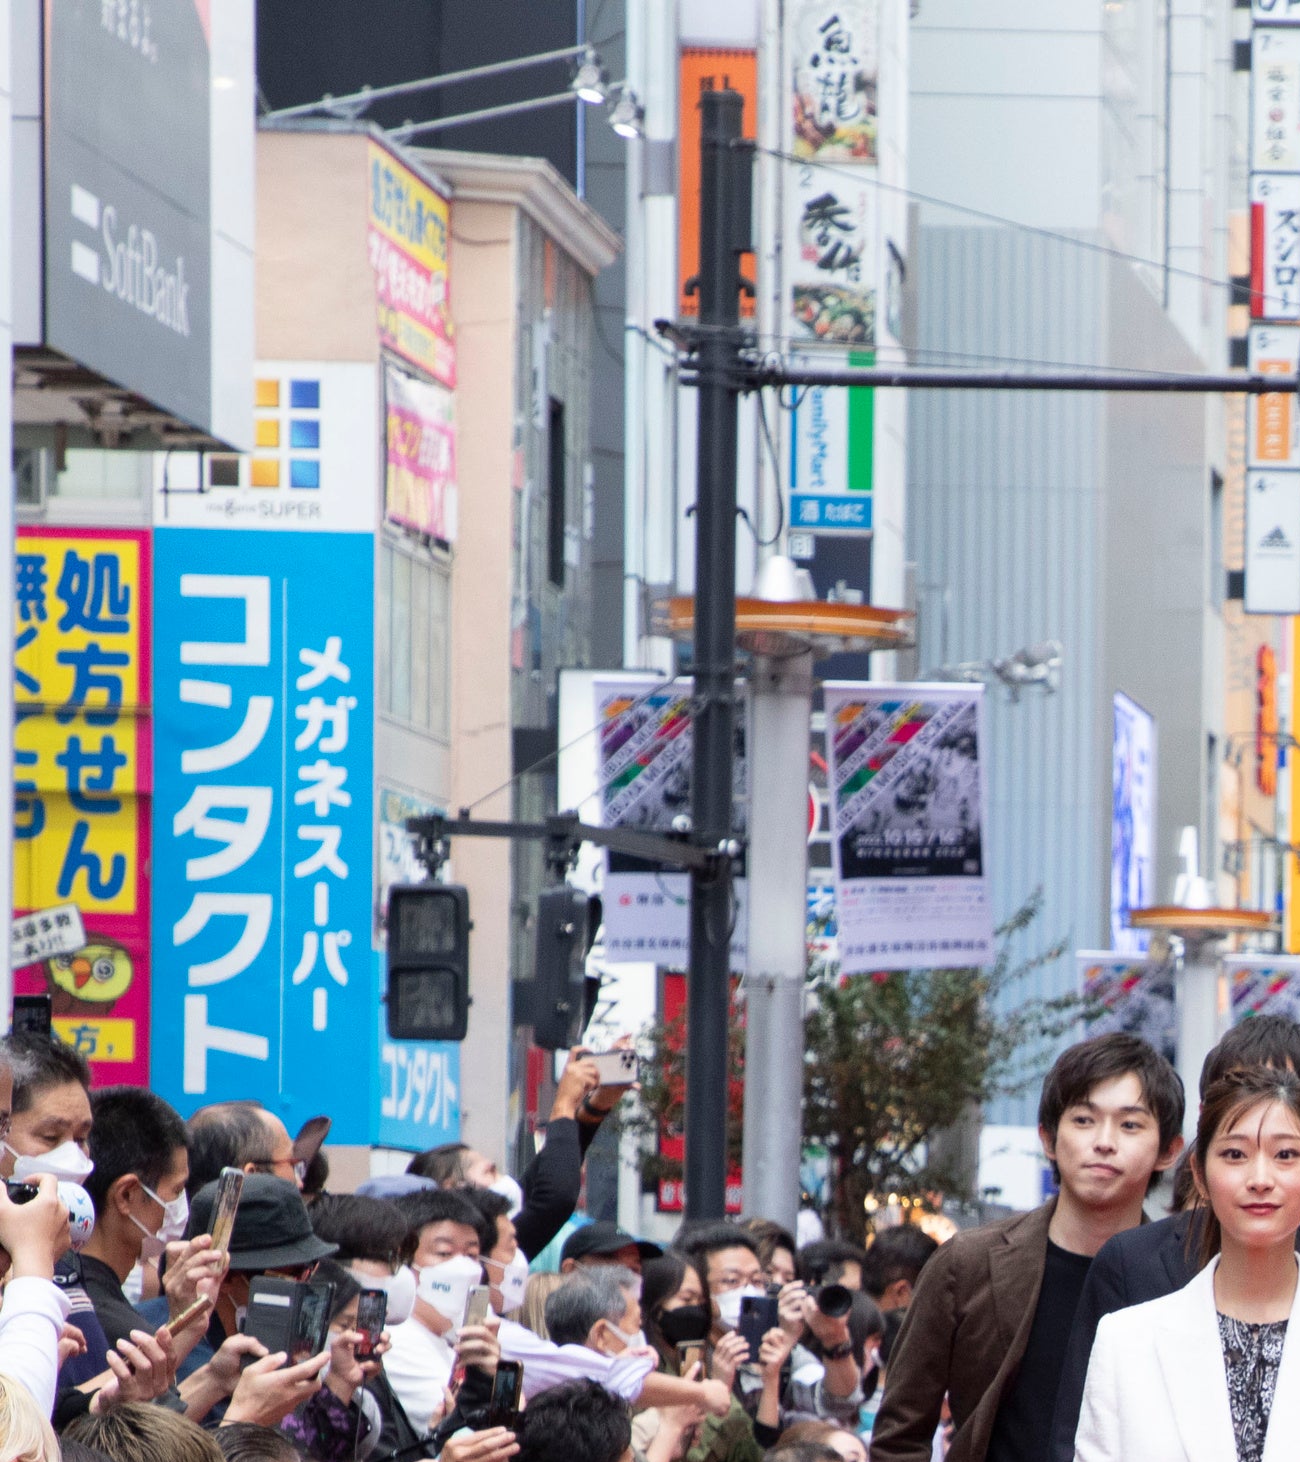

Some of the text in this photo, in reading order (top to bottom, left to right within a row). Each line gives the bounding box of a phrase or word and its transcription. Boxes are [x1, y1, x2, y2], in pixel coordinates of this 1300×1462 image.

[102, 204, 190, 337] SoftBank
[1274, 209, 1299, 310] スシロー
[810, 384, 828, 488] amilyMart
[55, 549, 132, 900] 処方せん
[173, 575, 274, 1095] コンタクト
[292, 636, 356, 1030] メガネスーパー
[381, 1044, 457, 1130] コンタクト
